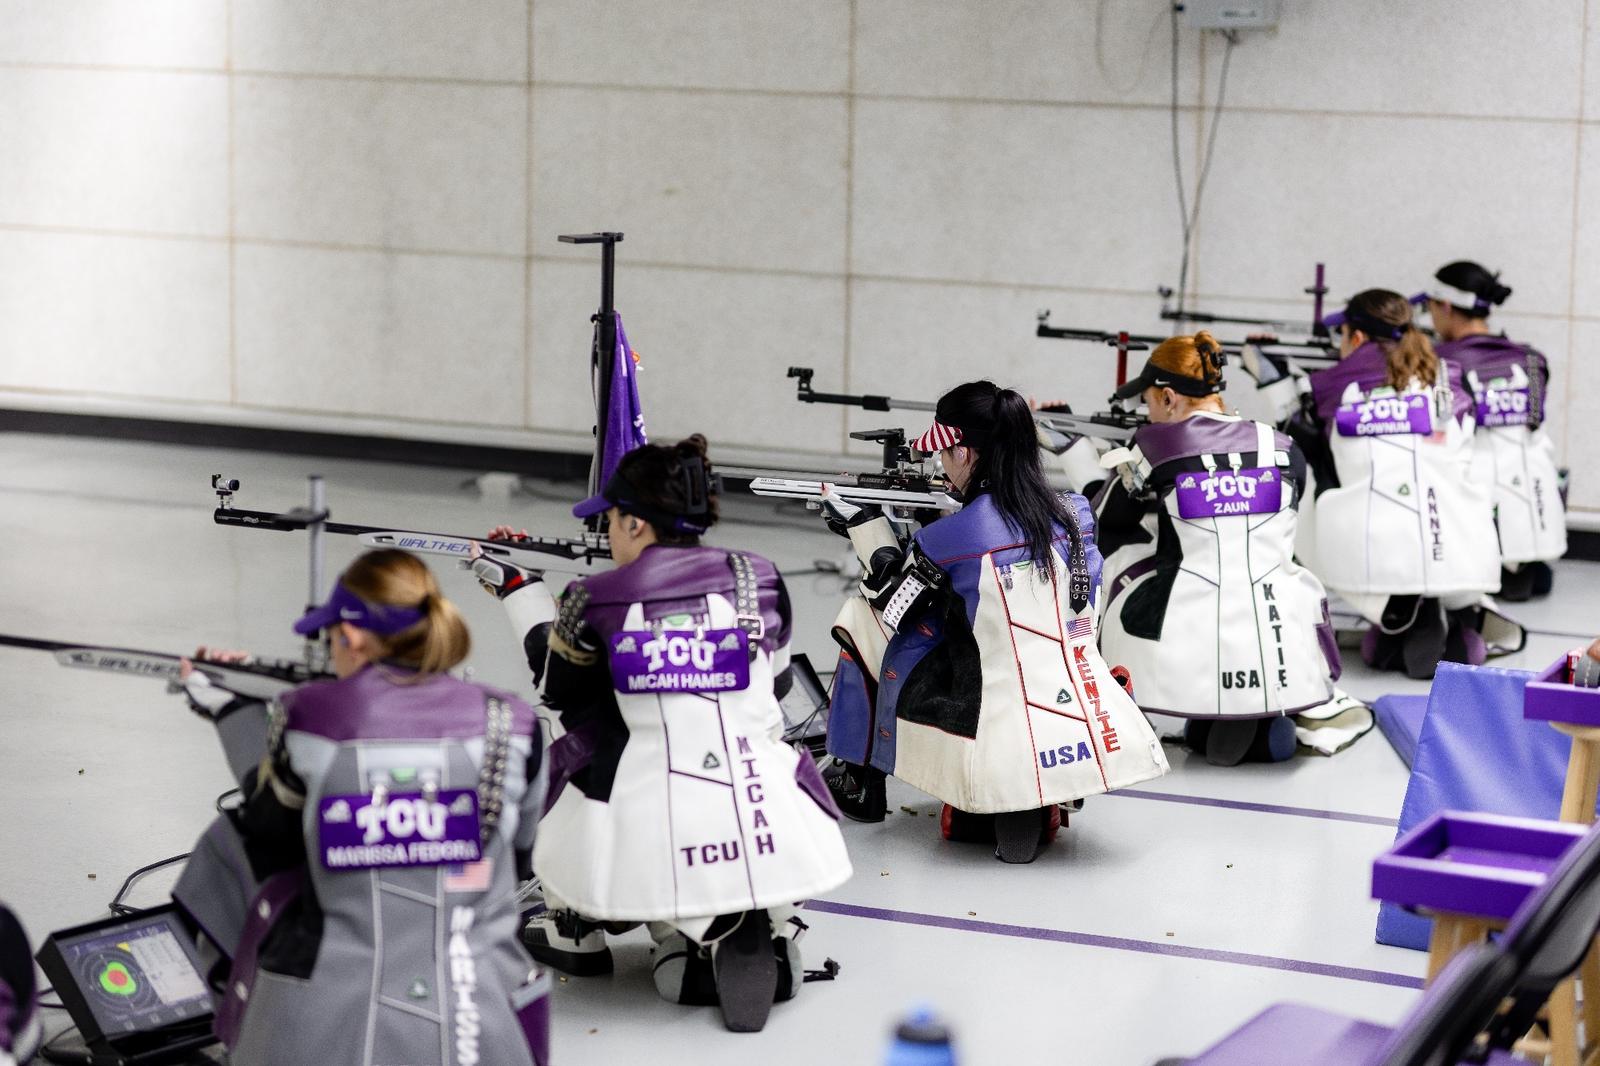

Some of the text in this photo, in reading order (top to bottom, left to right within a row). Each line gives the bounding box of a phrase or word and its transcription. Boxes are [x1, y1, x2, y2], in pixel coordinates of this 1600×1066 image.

[1357, 398, 1410, 424] TCU
[1355, 420, 1412, 435] DOWNUM
[1200, 475, 1258, 502] TCU
[1213, 501, 1250, 514] ZAUN
[1427, 487, 1444, 561] ANNIE
[398, 537, 472, 554] WALTHER
[1262, 583, 1288, 688] KATIE
[642, 636, 717, 672] TCU
[627, 672, 737, 690] MICAH HAMES
[1221, 669, 1260, 690] USA
[1073, 645, 1121, 753] KENZIE
[1039, 741, 1092, 769] USA
[736, 736, 775, 855] MICAH
[355, 798, 449, 845] TCU
[326, 843, 408, 867] MARISSA
[680, 840, 740, 867] TCU
[449, 905, 481, 1066] MARISS
